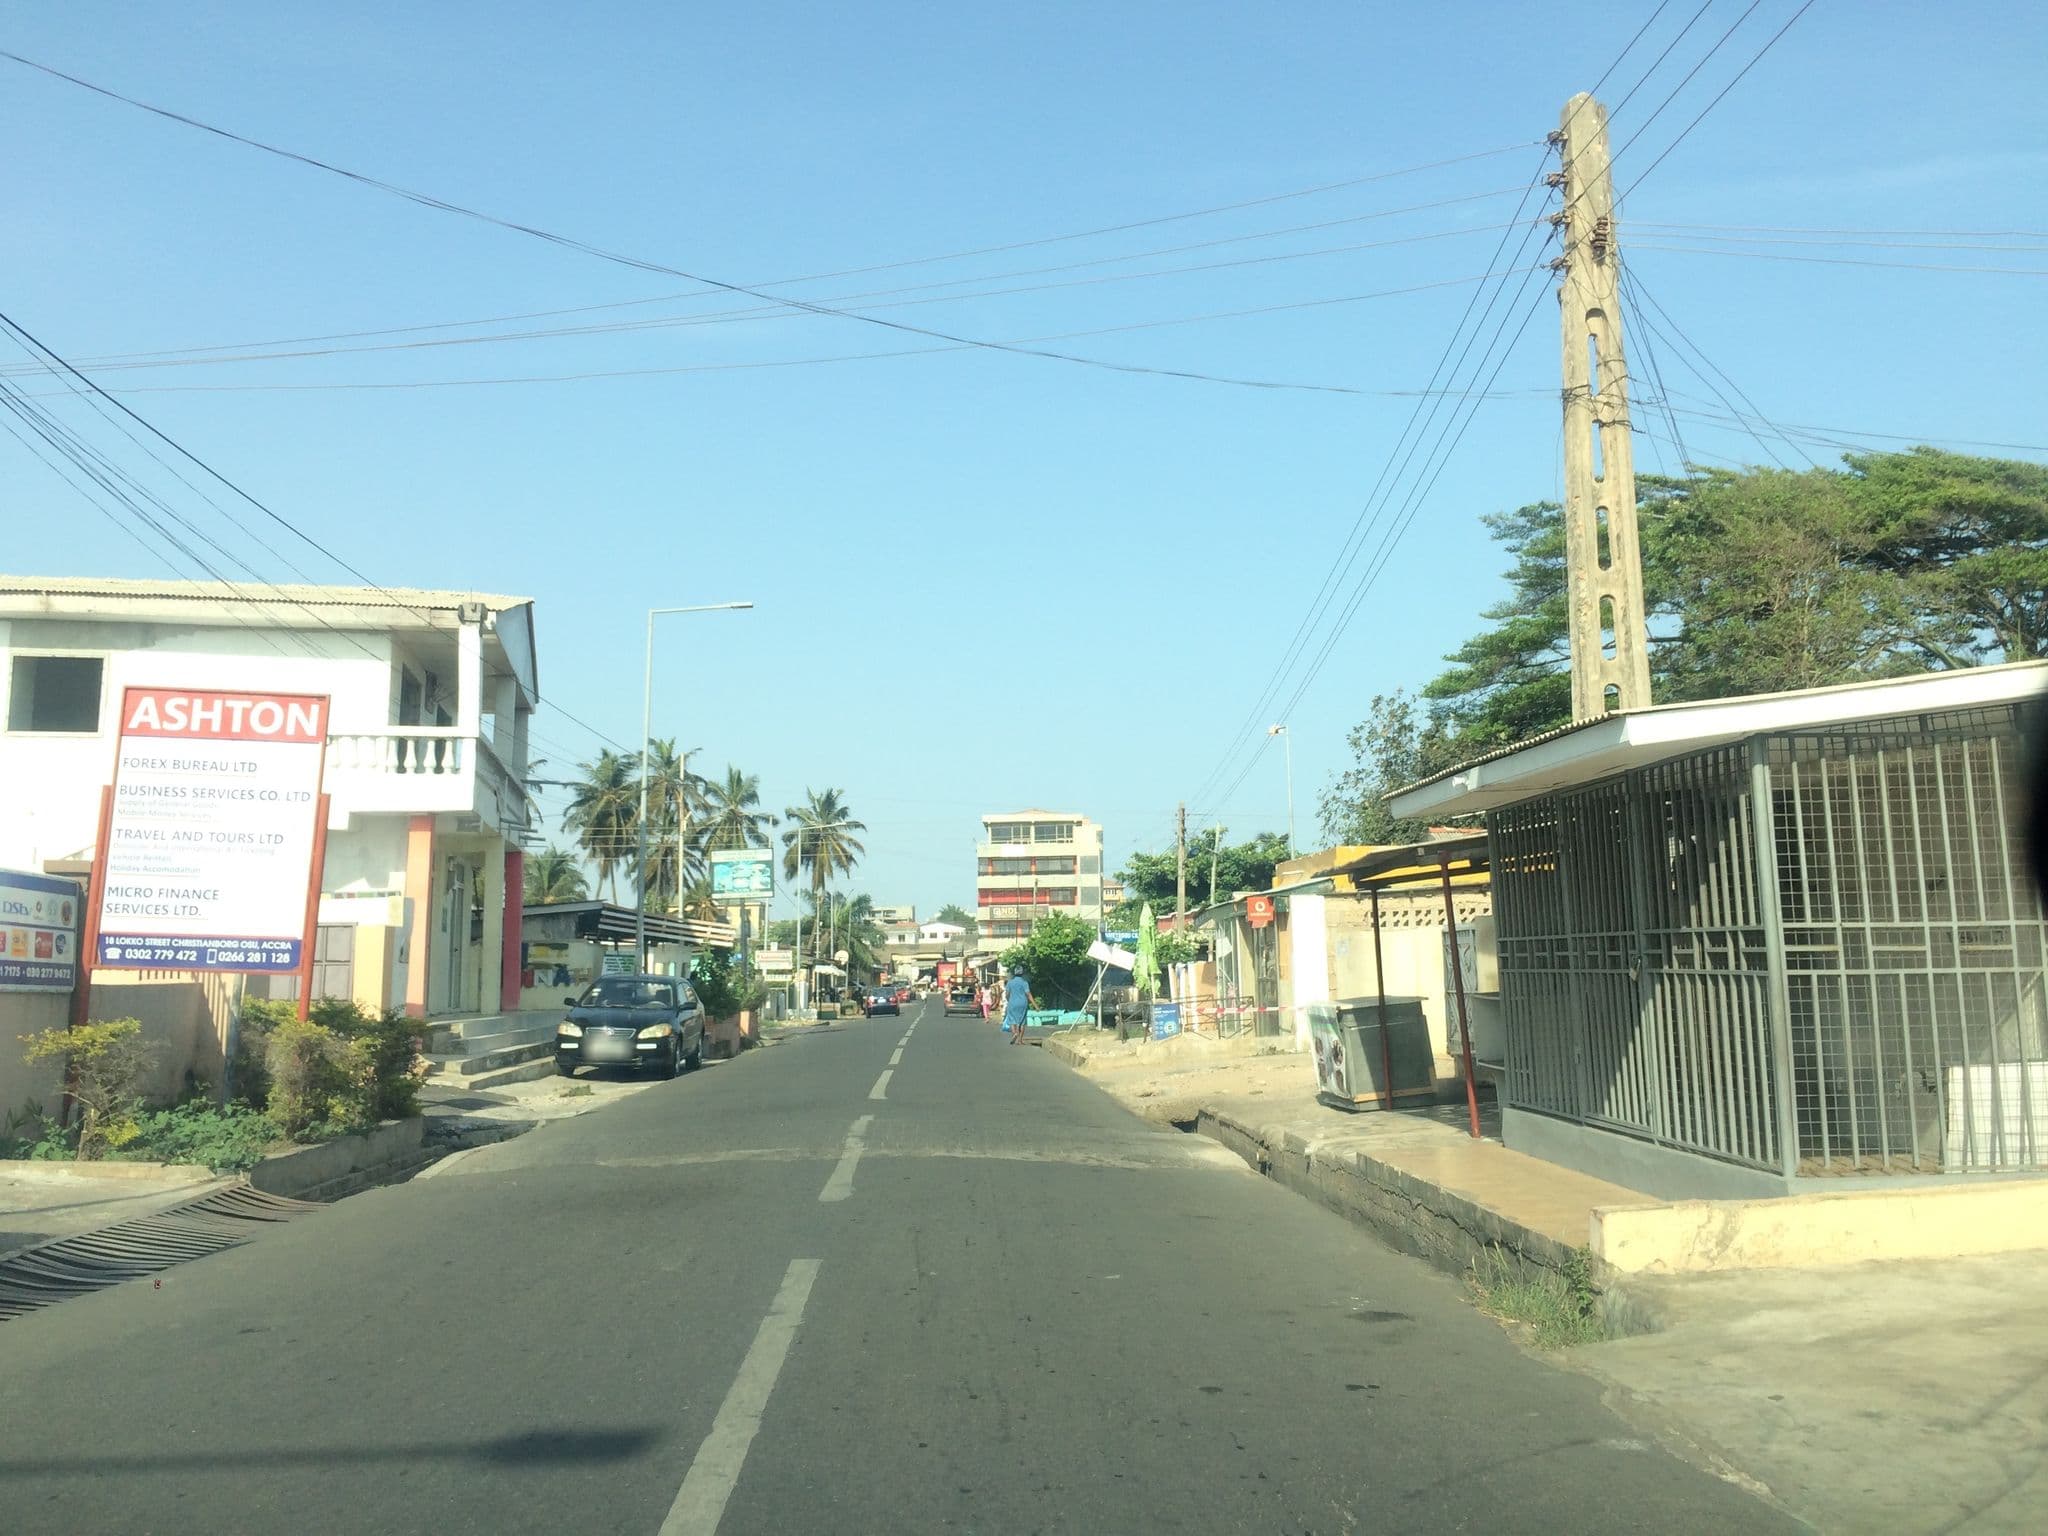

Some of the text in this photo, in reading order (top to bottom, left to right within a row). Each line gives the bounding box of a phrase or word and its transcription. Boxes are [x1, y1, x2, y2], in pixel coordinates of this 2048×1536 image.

[128, 696, 320, 737] ASHTON
[123, 757, 258, 773] FOREX BUREAU LTD
[120, 784, 311, 802] BUSINESS SERVICES CO. LTD
[116, 828, 284, 845] TRAVEL AND TOURS LTD
[107, 886, 219, 900] MICRO FINANCE
[105, 903, 202, 916] SERVICES LTD.
[145, 938, 171, 947] STREET
[261, 941, 292, 950] ACCRA
[125, 948, 197, 961] 0302 779 472
[218, 951, 290, 964] 0266 281 128
